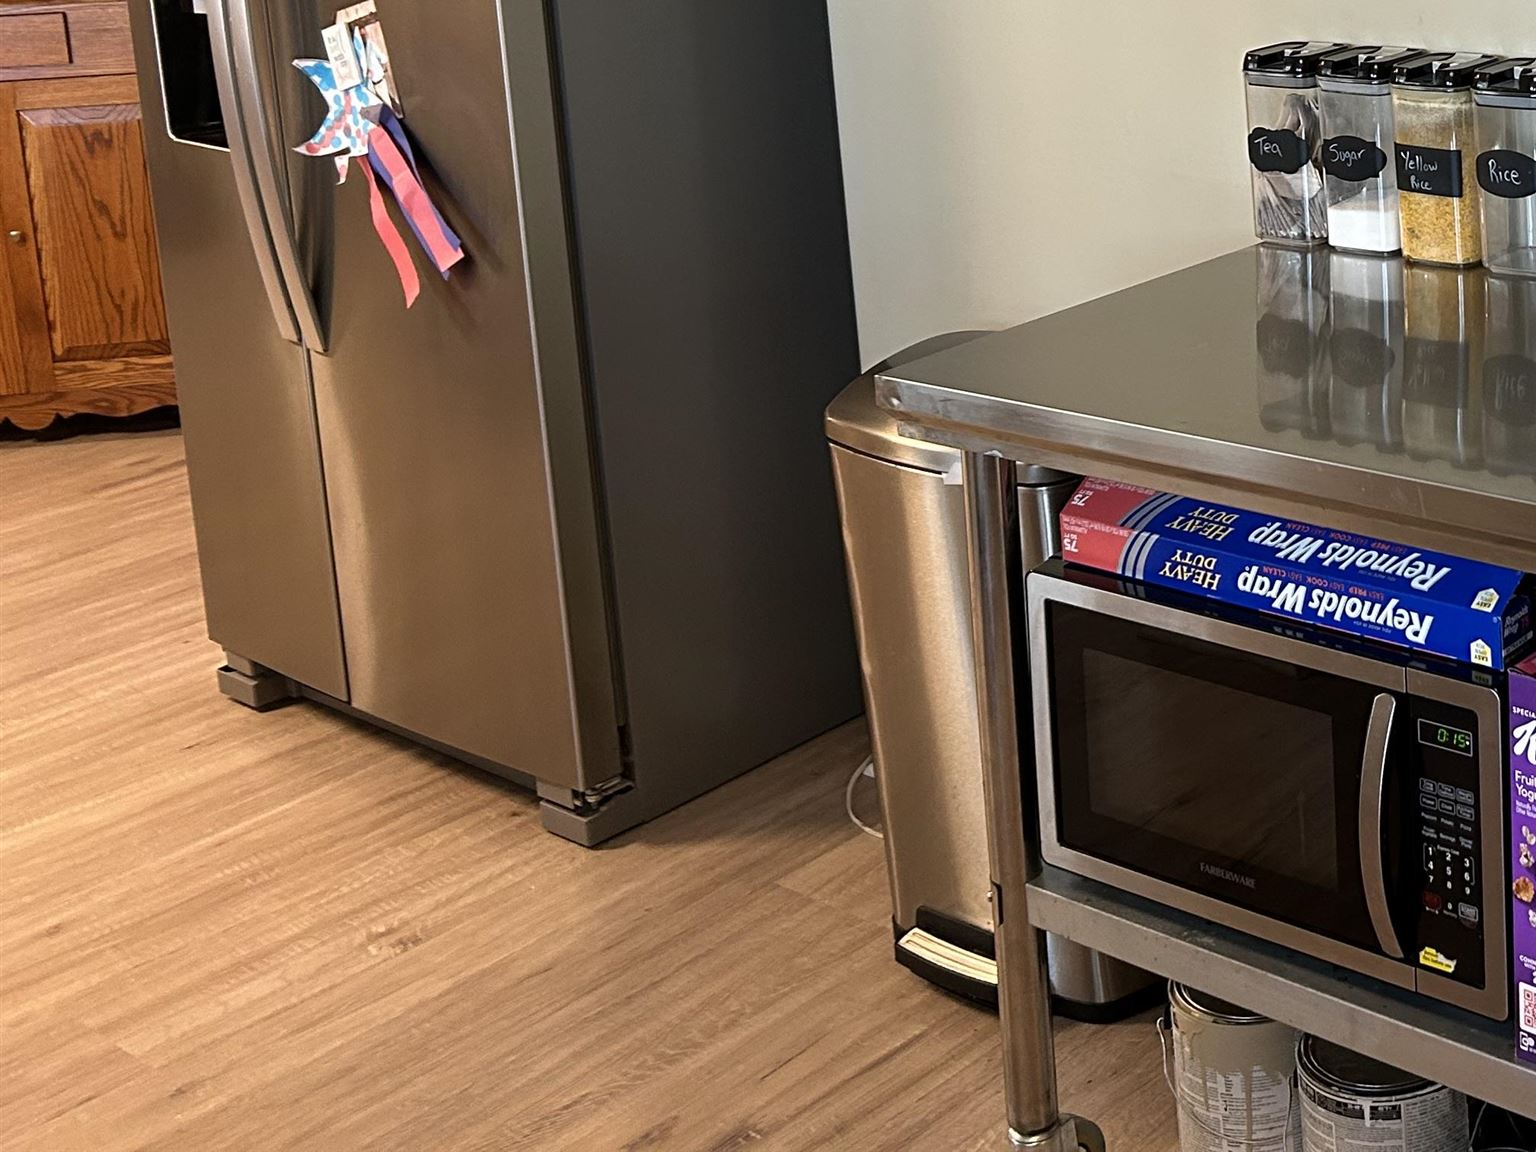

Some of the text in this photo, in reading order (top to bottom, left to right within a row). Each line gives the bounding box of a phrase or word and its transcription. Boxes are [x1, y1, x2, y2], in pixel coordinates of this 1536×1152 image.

[1254, 136, 1283, 158] Tea
[1329, 143, 1366, 167] Sugar
[1400, 151, 1439, 172] Yellow
[1410, 174, 1432, 190] Rice
[1488, 159, 1522, 185] Rice
[1071, 493, 1091, 506] 75
[1188, 506, 1241, 525] DUTY
[1165, 516, 1235, 542] HEAVY
[1330, 531, 1356, 542] COOK
[1063, 538, 1079, 553] 75
[1171, 549, 1218, 570] DUTY
[1248, 521, 1452, 592] Reynolds Wrap
[1159, 561, 1222, 591] HEAVY
[1263, 566, 1286, 577] CLEAN
[1306, 576, 1329, 587] COOK
[1349, 586, 1368, 597] PREP
[1237, 565, 1434, 645] Reynolds Wrap
[1437, 729, 1466, 748] 0:15
